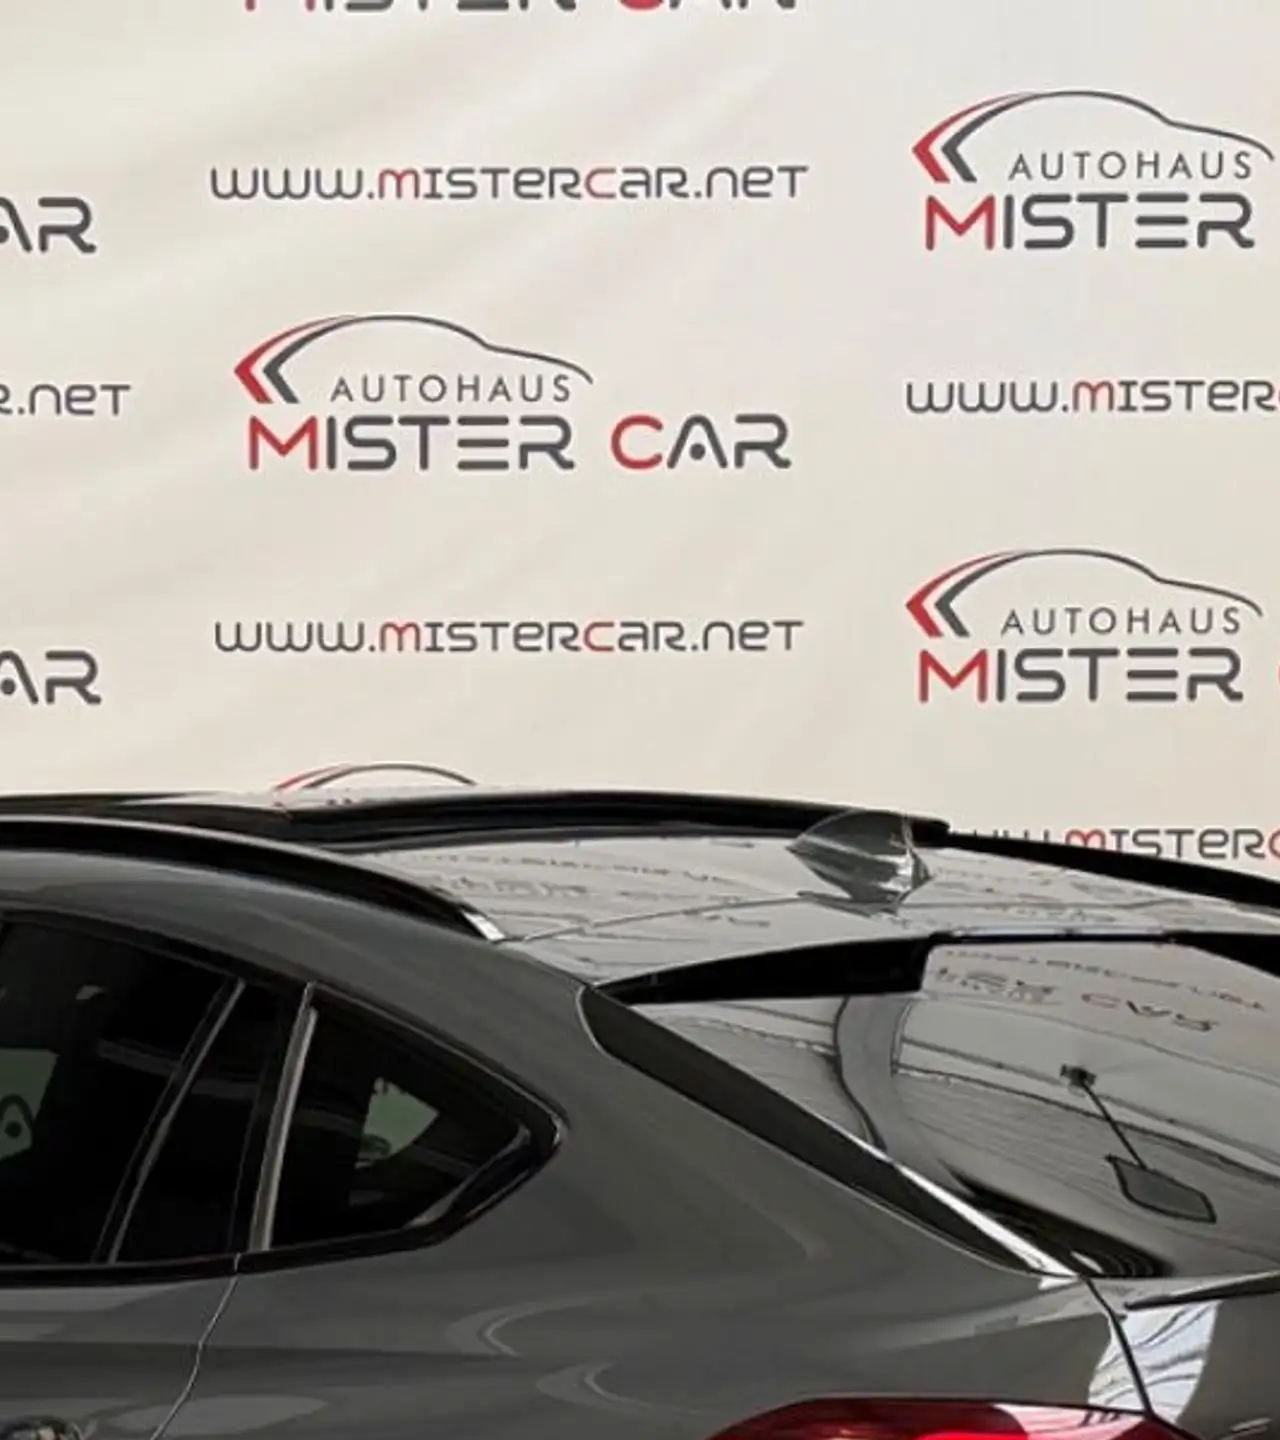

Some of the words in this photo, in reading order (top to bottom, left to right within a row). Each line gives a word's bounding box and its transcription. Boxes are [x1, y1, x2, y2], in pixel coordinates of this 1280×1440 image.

[1008, 150, 1252, 181] AUTOHAUS
[923, 190, 1257, 253] MISTER
[330, 372, 572, 403] AUTOHAUS
[247, 413, 577, 473] MISTER
[609, 412, 794, 472] CAR
[1000, 605, 1241, 636] AUTOHAUS
[917, 645, 1245, 705] MISTER
